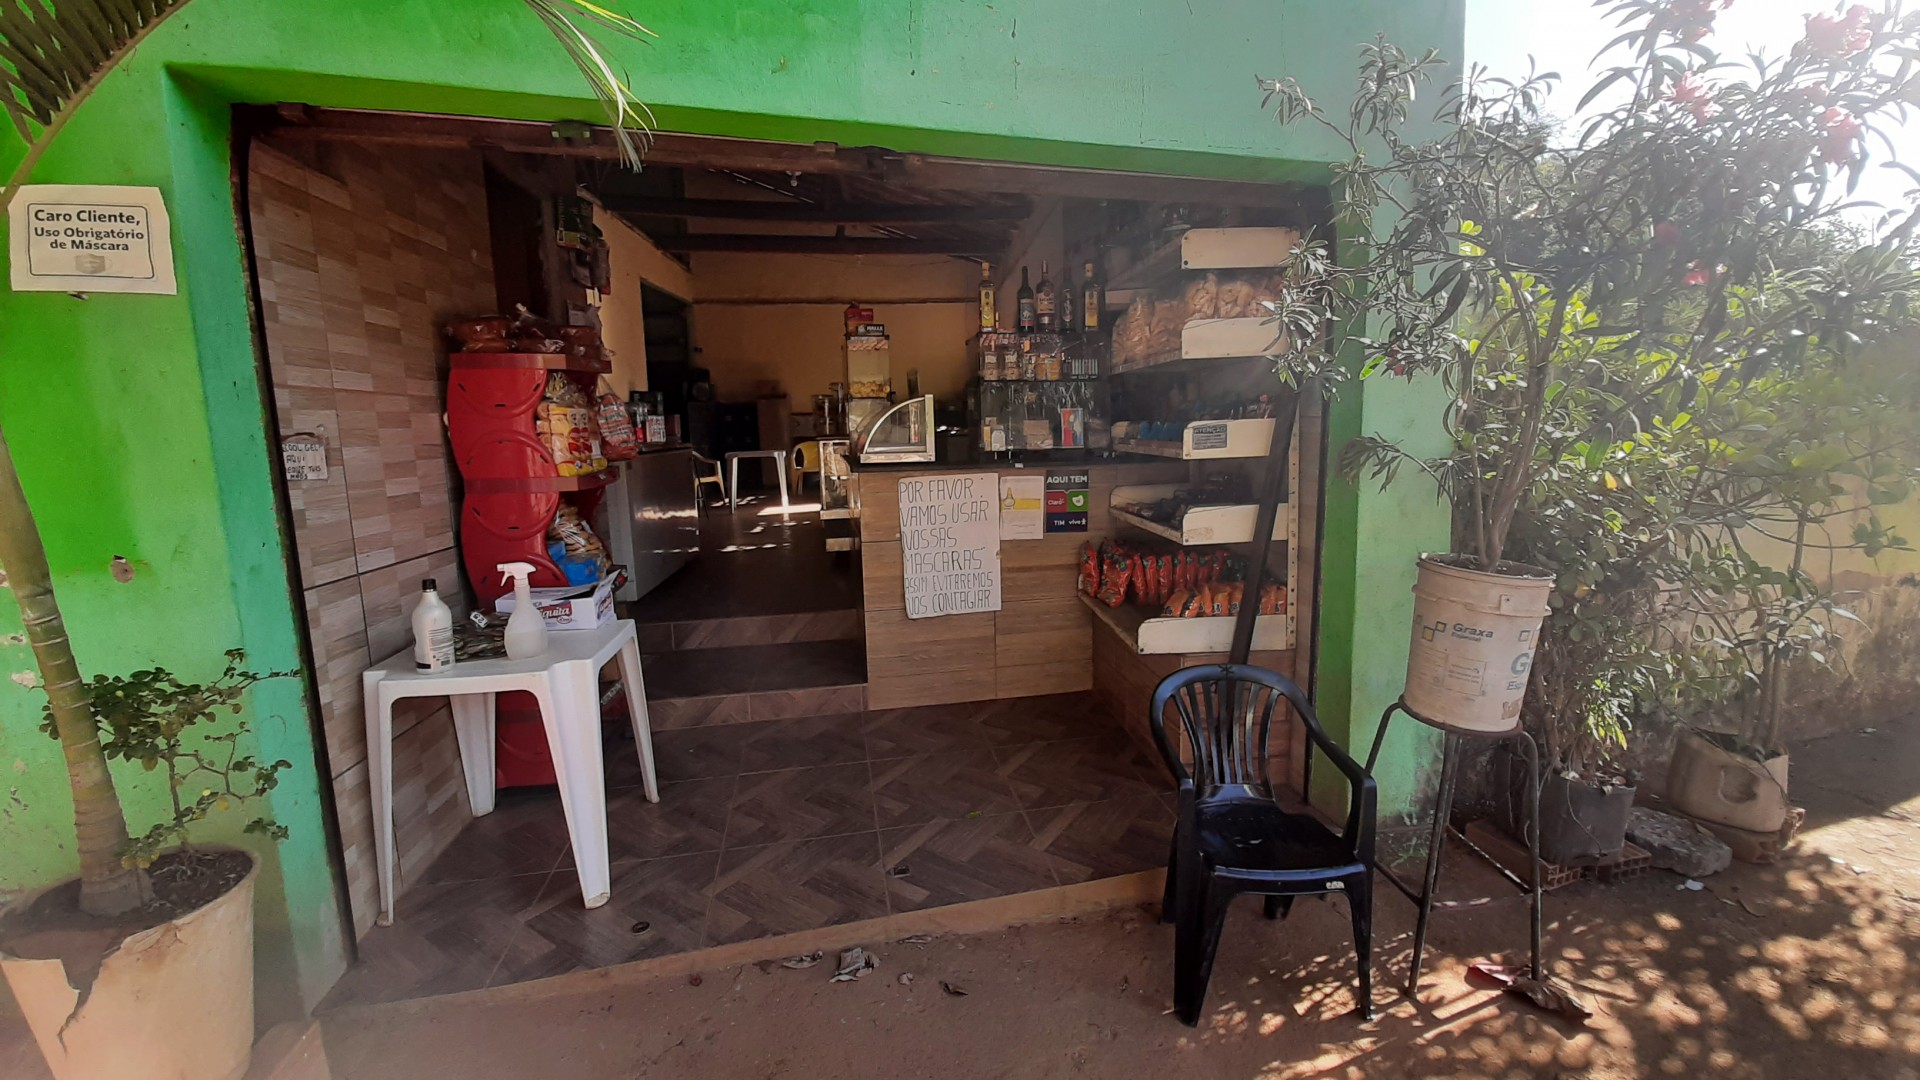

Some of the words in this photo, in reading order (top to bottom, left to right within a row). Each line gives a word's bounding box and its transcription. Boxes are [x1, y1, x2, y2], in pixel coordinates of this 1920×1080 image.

[34, 209, 72, 222] Caro
[76, 209, 141, 226] Cliente,
[34, 227, 60, 237] Uso
[64, 227, 144, 240] Obrigatório
[50, 239, 67, 249] de
[71, 239, 129, 251] Máscara
[1046, 475, 1068, 484] AQUI
[1069, 475, 1088, 483] TEM
[899, 480, 923, 504] POR
[900, 503, 948, 528] VAMOS
[951, 500, 989, 524] USAR
[901, 526, 958, 551] NOSSAS
[905, 575, 928, 594] ASSIM
[932, 571, 994, 592] EVITAREMOS
[932, 589, 991, 613] CONTAGIAR
[1453, 622, 1493, 638] Graxa
